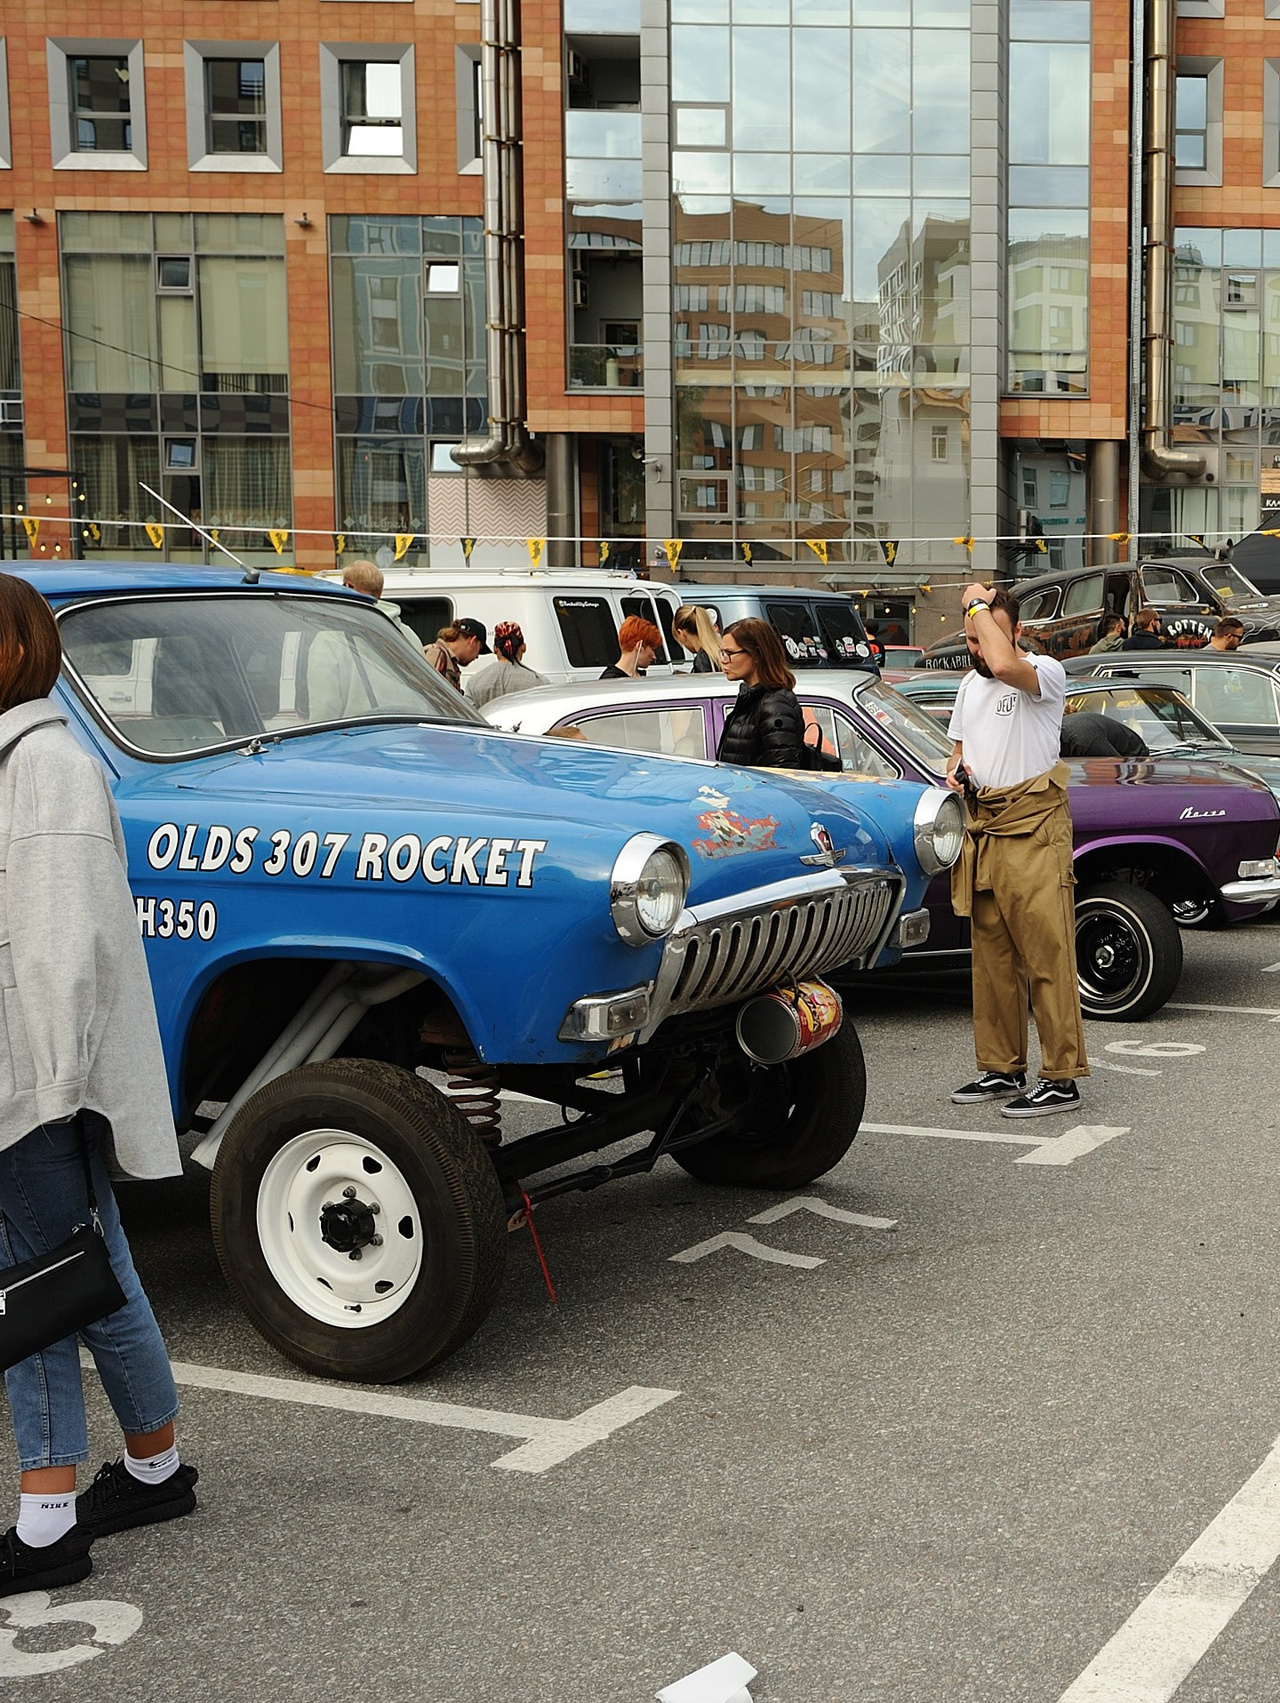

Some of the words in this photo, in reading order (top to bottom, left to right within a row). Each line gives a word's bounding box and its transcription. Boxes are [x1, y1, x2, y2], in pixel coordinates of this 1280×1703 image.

[1167, 619, 1213, 642] ROTTEN
[147, 822, 260, 874] OLDS
[264, 829, 352, 879] 307
[355, 832, 548, 888] ROCKET
